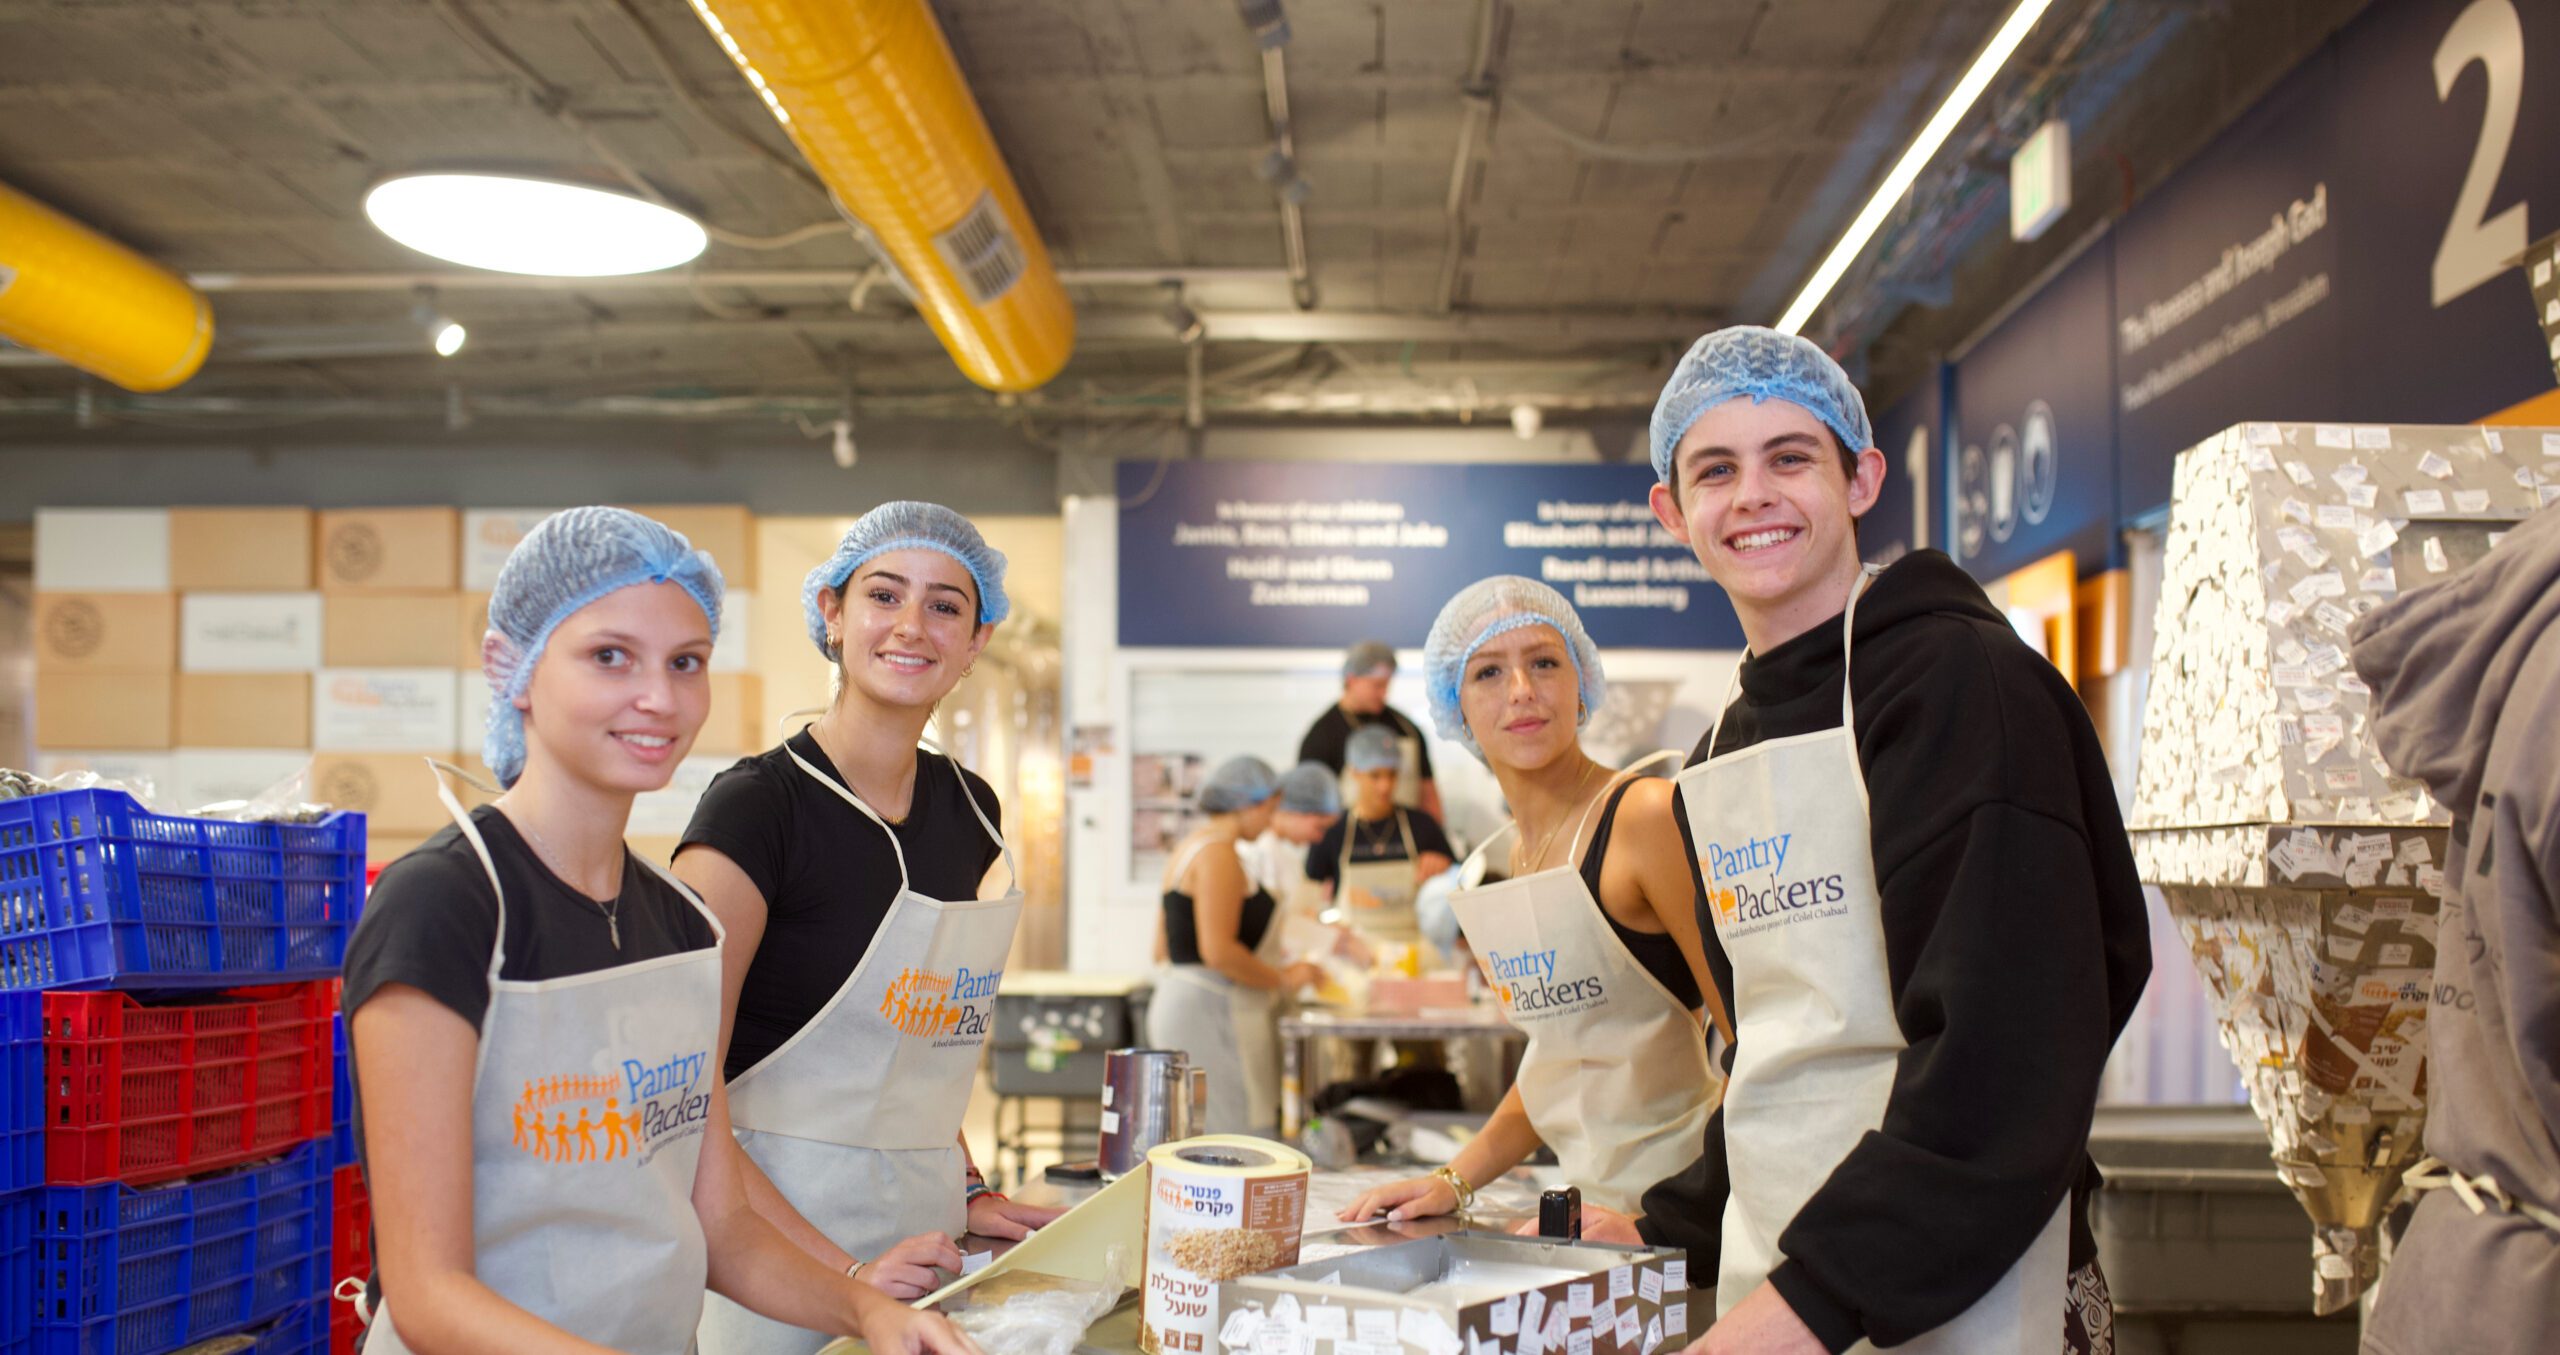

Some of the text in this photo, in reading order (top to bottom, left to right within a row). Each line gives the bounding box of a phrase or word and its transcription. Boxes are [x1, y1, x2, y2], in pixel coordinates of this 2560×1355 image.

[2431, 0, 2528, 310] 2
[2202, 248, 2235, 306] and
[2287, 181, 2328, 245] Gad
[1906, 424, 1929, 550] 1
[1354, 523, 1397, 547] and
[1505, 522, 1603, 547] Elizabeth
[1604, 523, 1647, 547] and
[1285, 556, 1328, 580] and
[1607, 556, 1648, 581] and
[1709, 833, 1791, 881] Pantry
[1734, 873, 1844, 923] Packers
[1792, 909, 1814, 923] Colel
[1814, 904, 1849, 920] Chabad
[1489, 949, 1556, 983] Pantry
[951, 968, 1002, 1000] Pantr
[1511, 976, 1603, 1012] Packers
[622, 1051, 706, 1104] Pantry
[642, 1086, 712, 1144] Packer
[1184, 1183, 1222, 1200] פנטרי
[1195, 1200, 1234, 1217] פקרס
[1151, 1272, 1209, 1298] שיבולת
[1164, 1293, 1208, 1318] שועל
